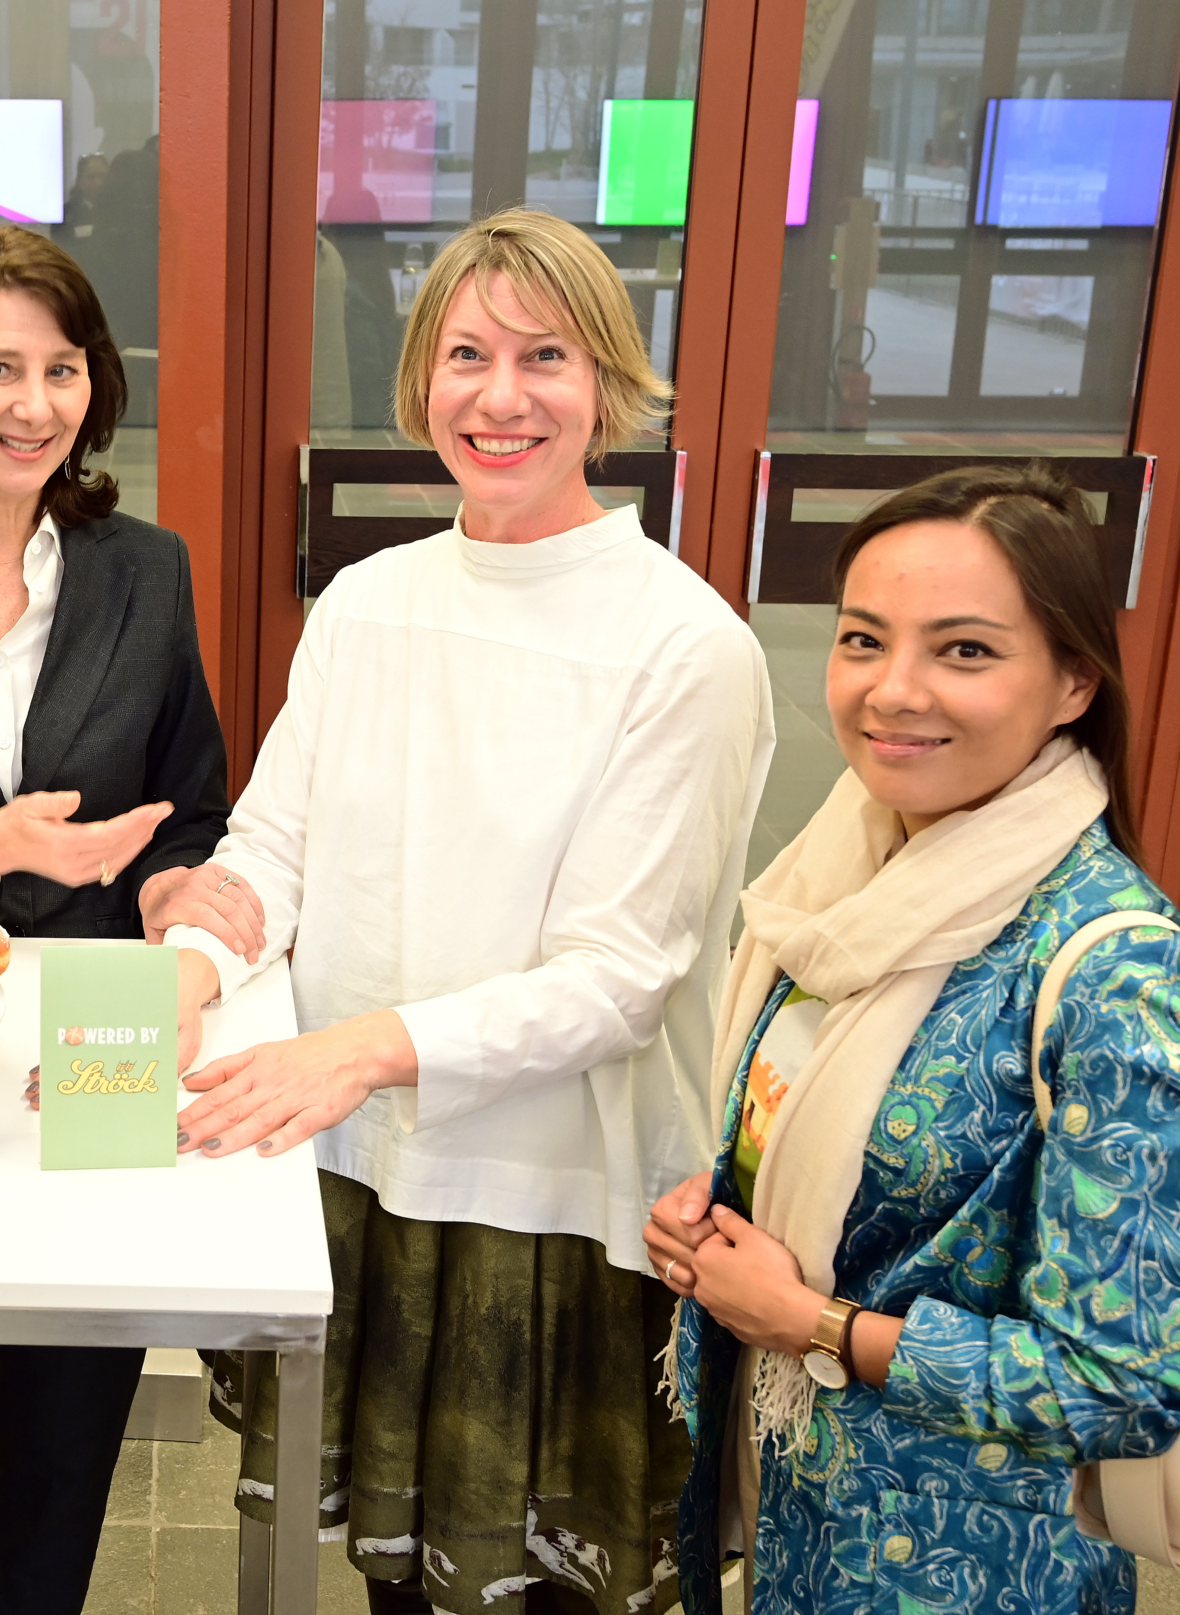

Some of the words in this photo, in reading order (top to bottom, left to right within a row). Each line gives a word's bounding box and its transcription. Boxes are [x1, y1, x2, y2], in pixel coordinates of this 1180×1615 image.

[59, 1026, 135, 1045] POWERED
[141, 1028, 160, 1044] BY
[58, 1060, 159, 1095] Ströck
